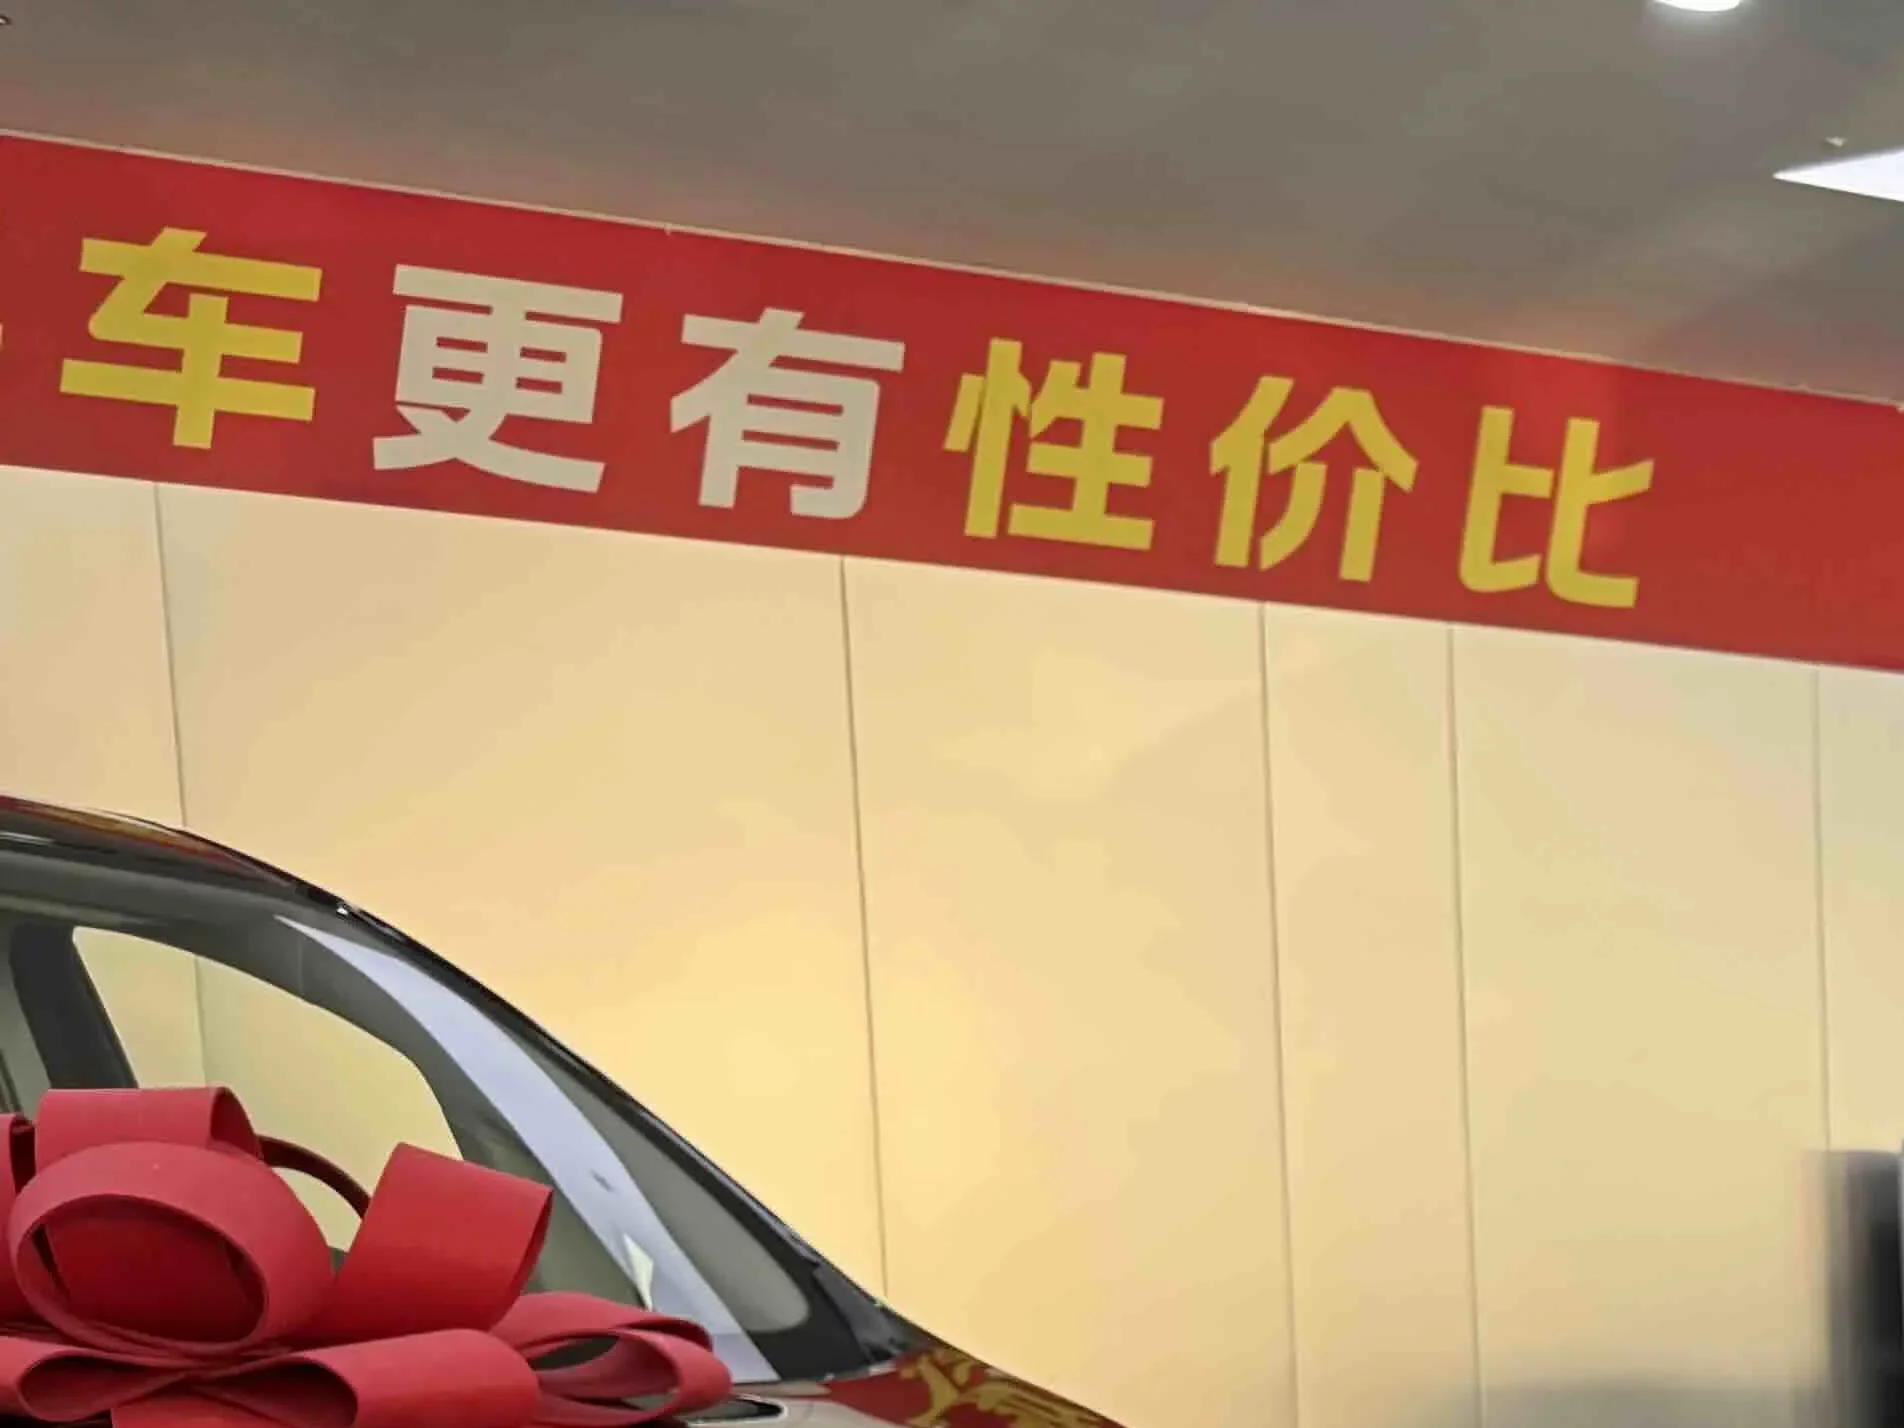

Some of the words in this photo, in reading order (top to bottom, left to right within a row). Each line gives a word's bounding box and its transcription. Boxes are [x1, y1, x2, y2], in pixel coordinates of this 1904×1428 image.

[60, 226, 1656, 609] 车更有性价比
